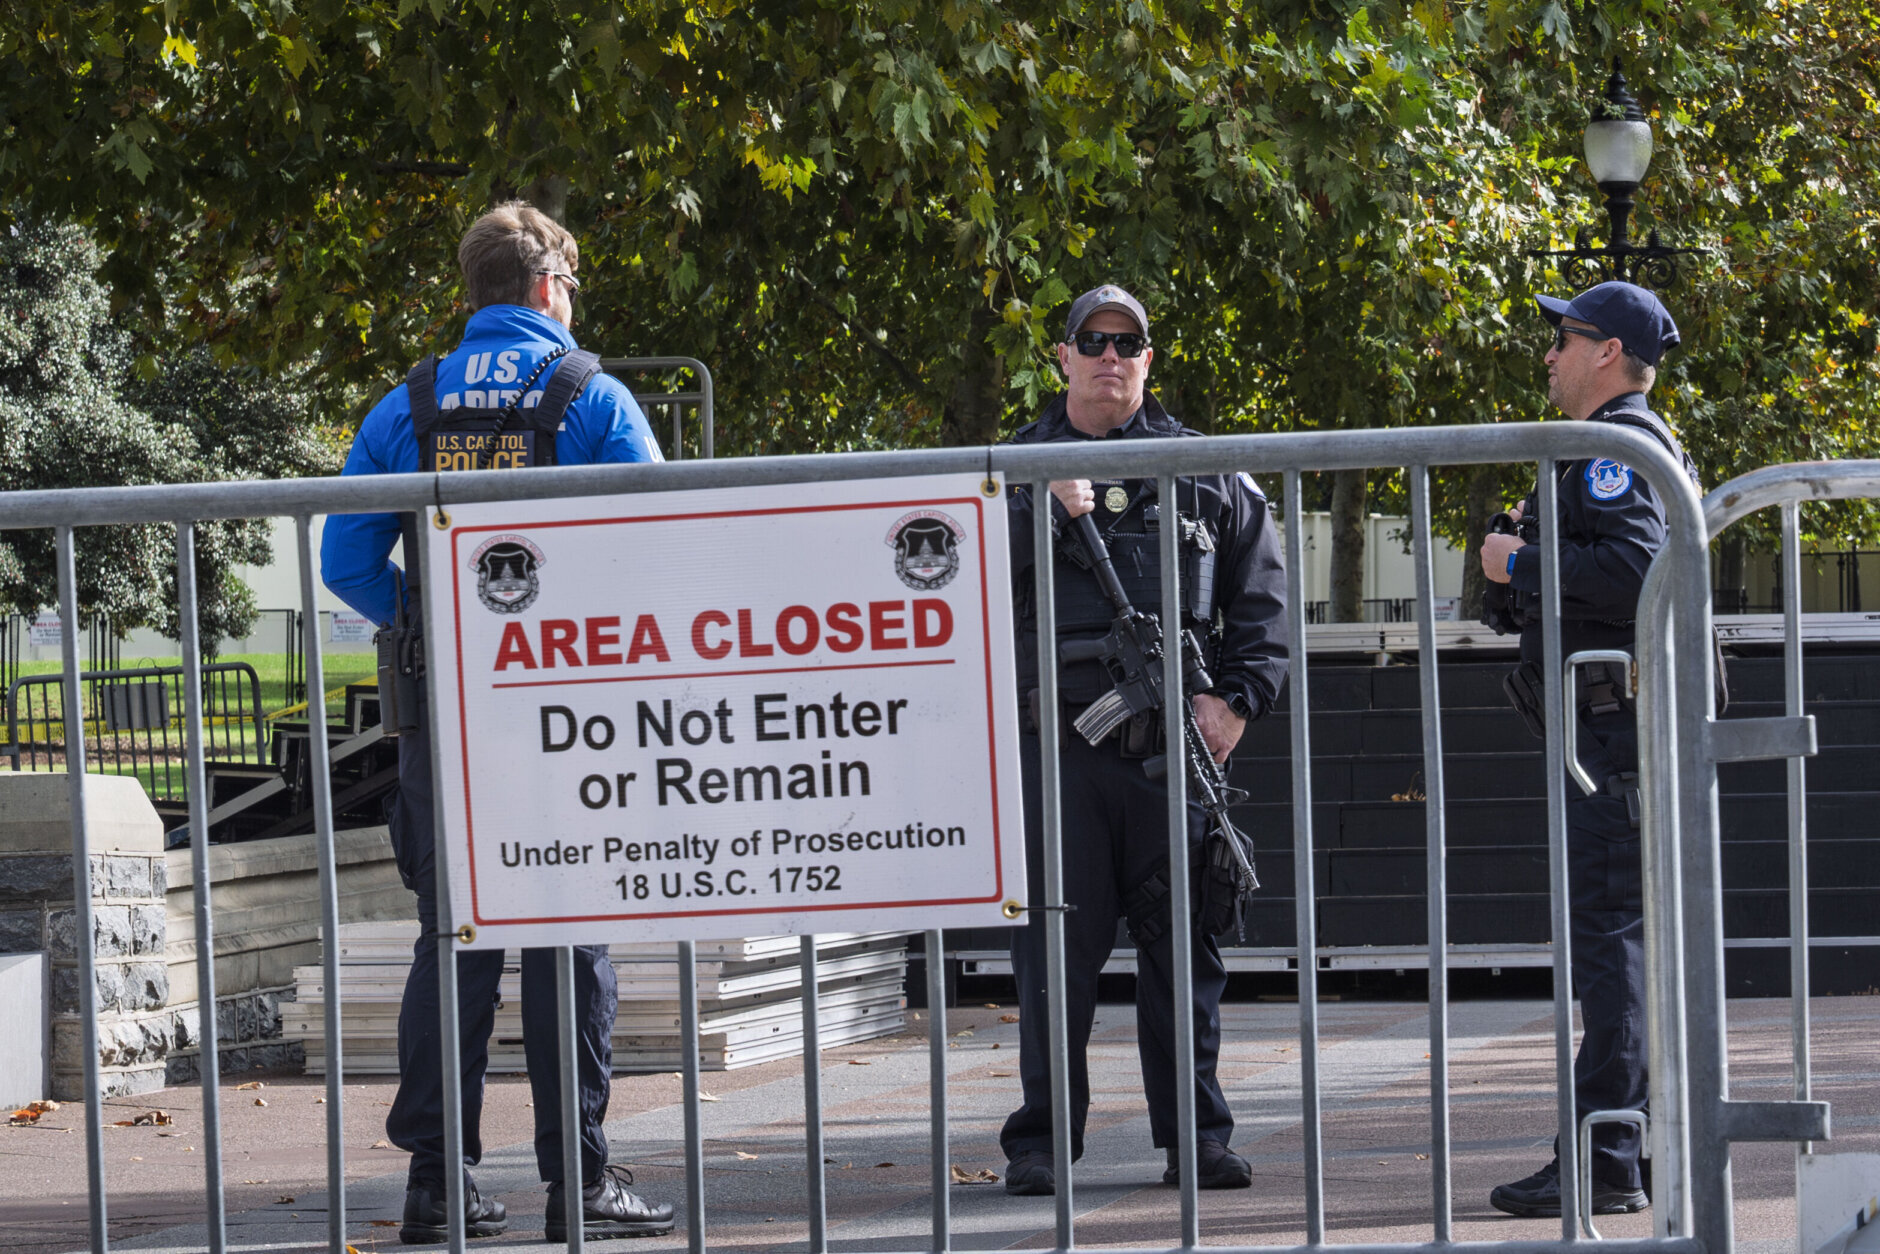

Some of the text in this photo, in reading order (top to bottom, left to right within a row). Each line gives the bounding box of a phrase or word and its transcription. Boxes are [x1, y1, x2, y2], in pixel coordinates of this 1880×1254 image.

[464, 350, 523, 384] U.S.
[437, 435, 462, 450] U.S.
[493, 598, 955, 671] AREA CLOSED
[540, 691, 908, 753] Do Not Enter
[579, 749, 871, 810] or Remain
[500, 822, 966, 868] Under Penalty of Prosecution
[615, 864, 842, 901] 18 U.S.C. 1752
